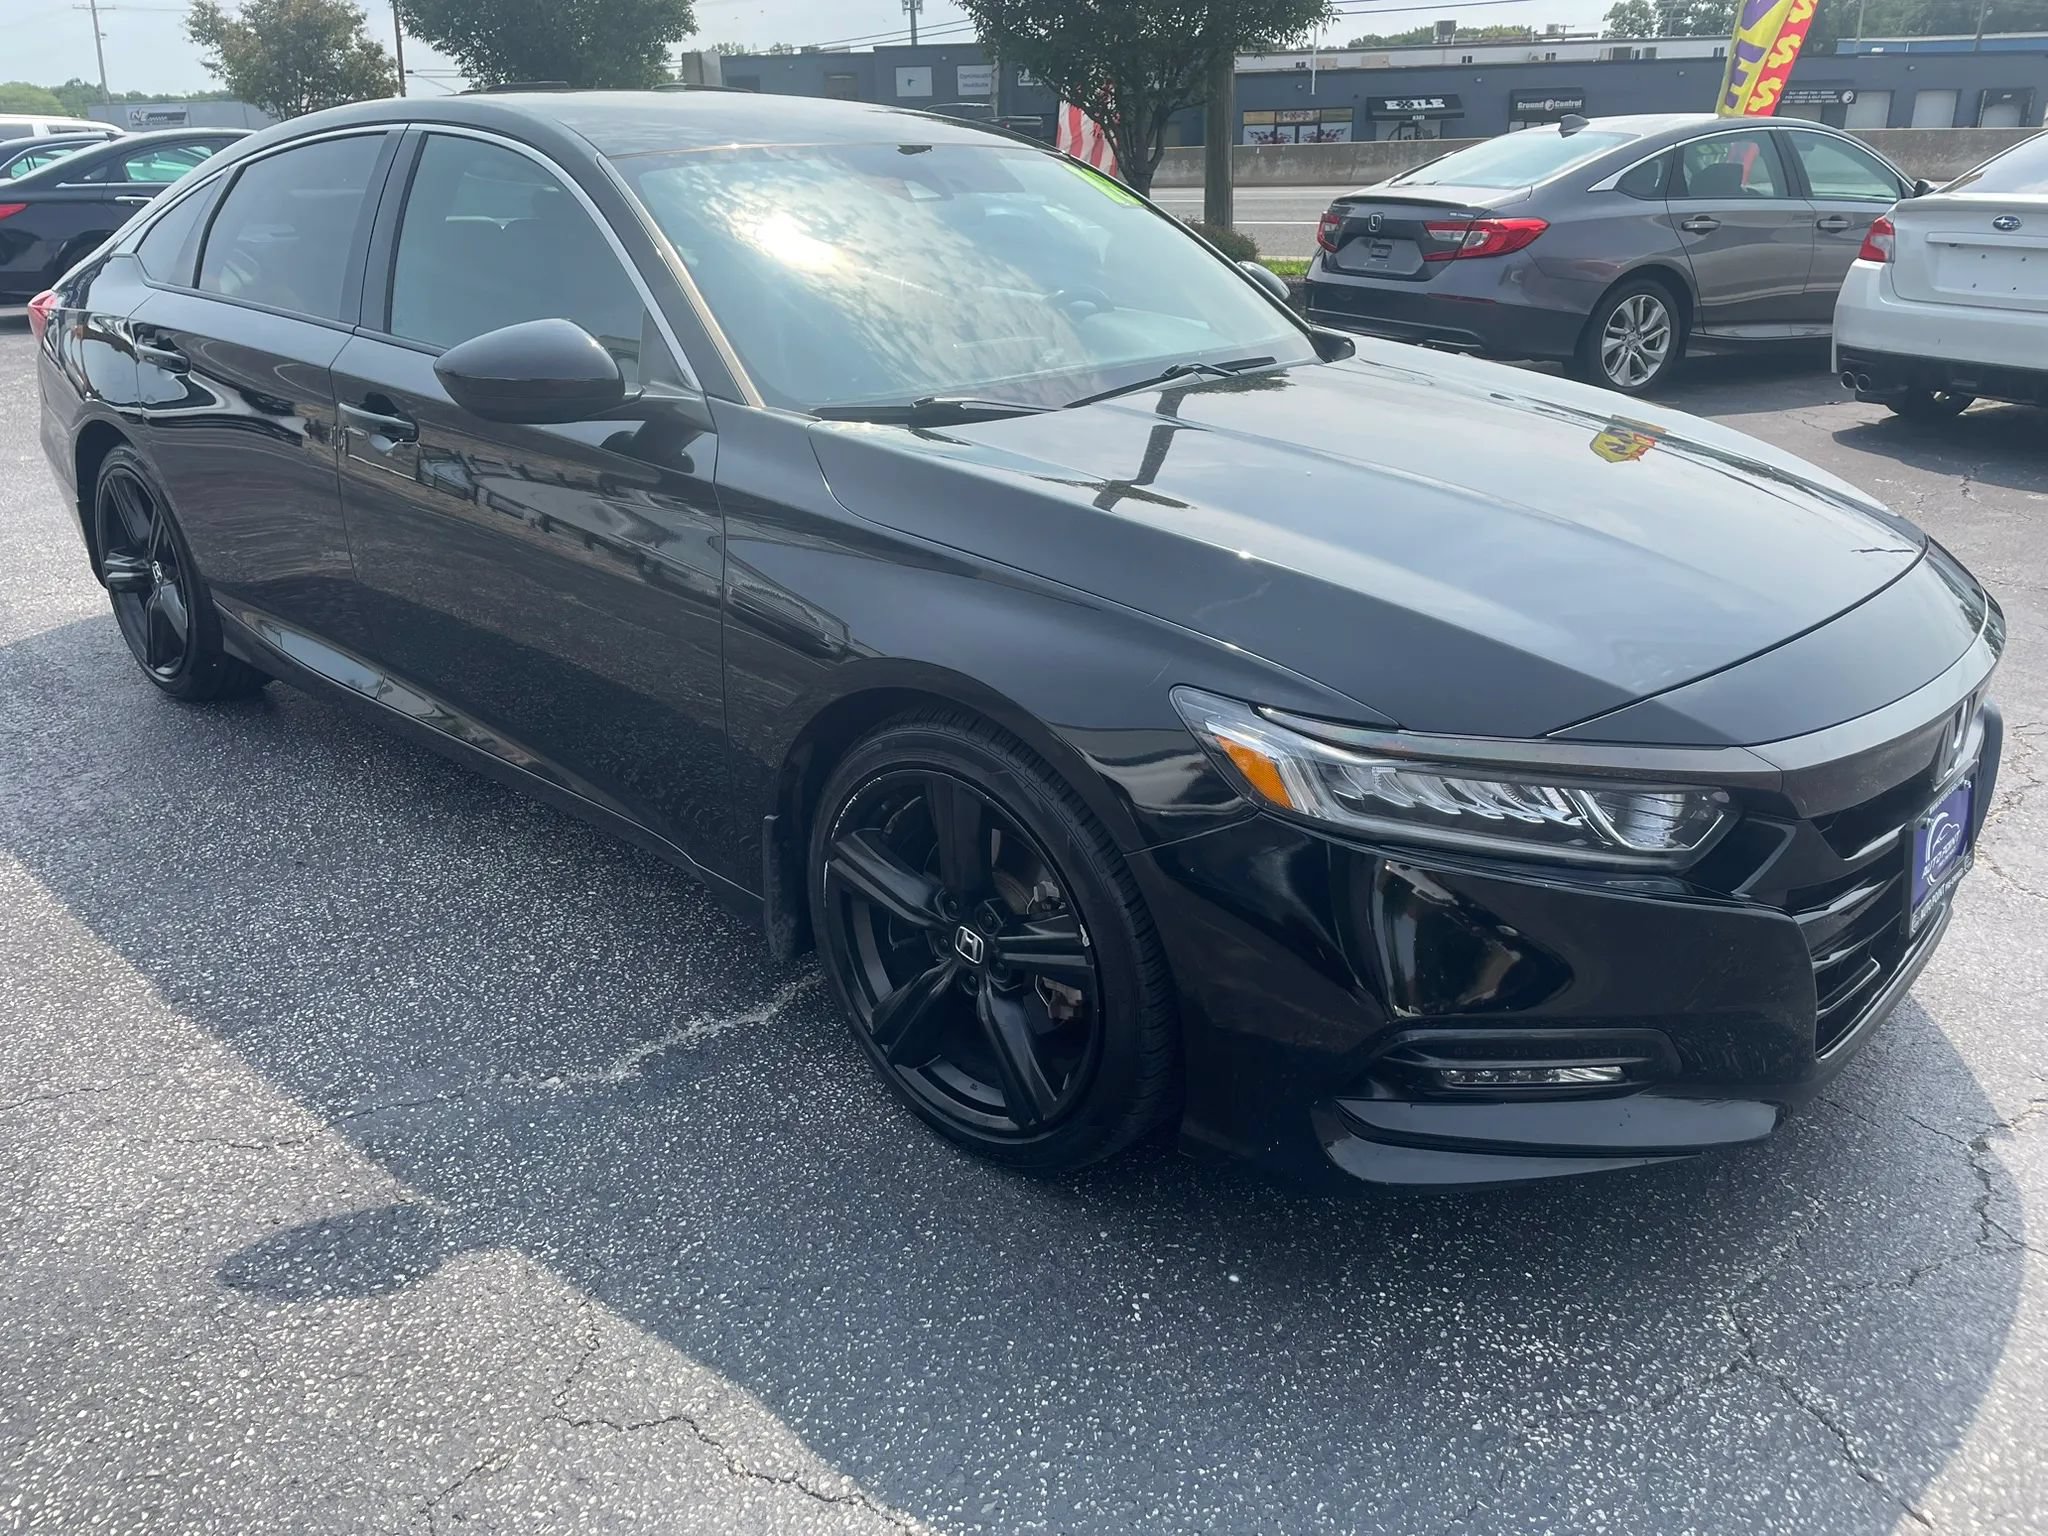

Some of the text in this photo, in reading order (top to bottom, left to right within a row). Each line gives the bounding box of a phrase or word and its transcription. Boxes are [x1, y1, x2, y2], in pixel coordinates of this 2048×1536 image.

[1384, 98, 1446, 110] EXILE
[1517, 99, 1583, 109] Ground Control
[1921, 850, 1942, 880] AUTO
